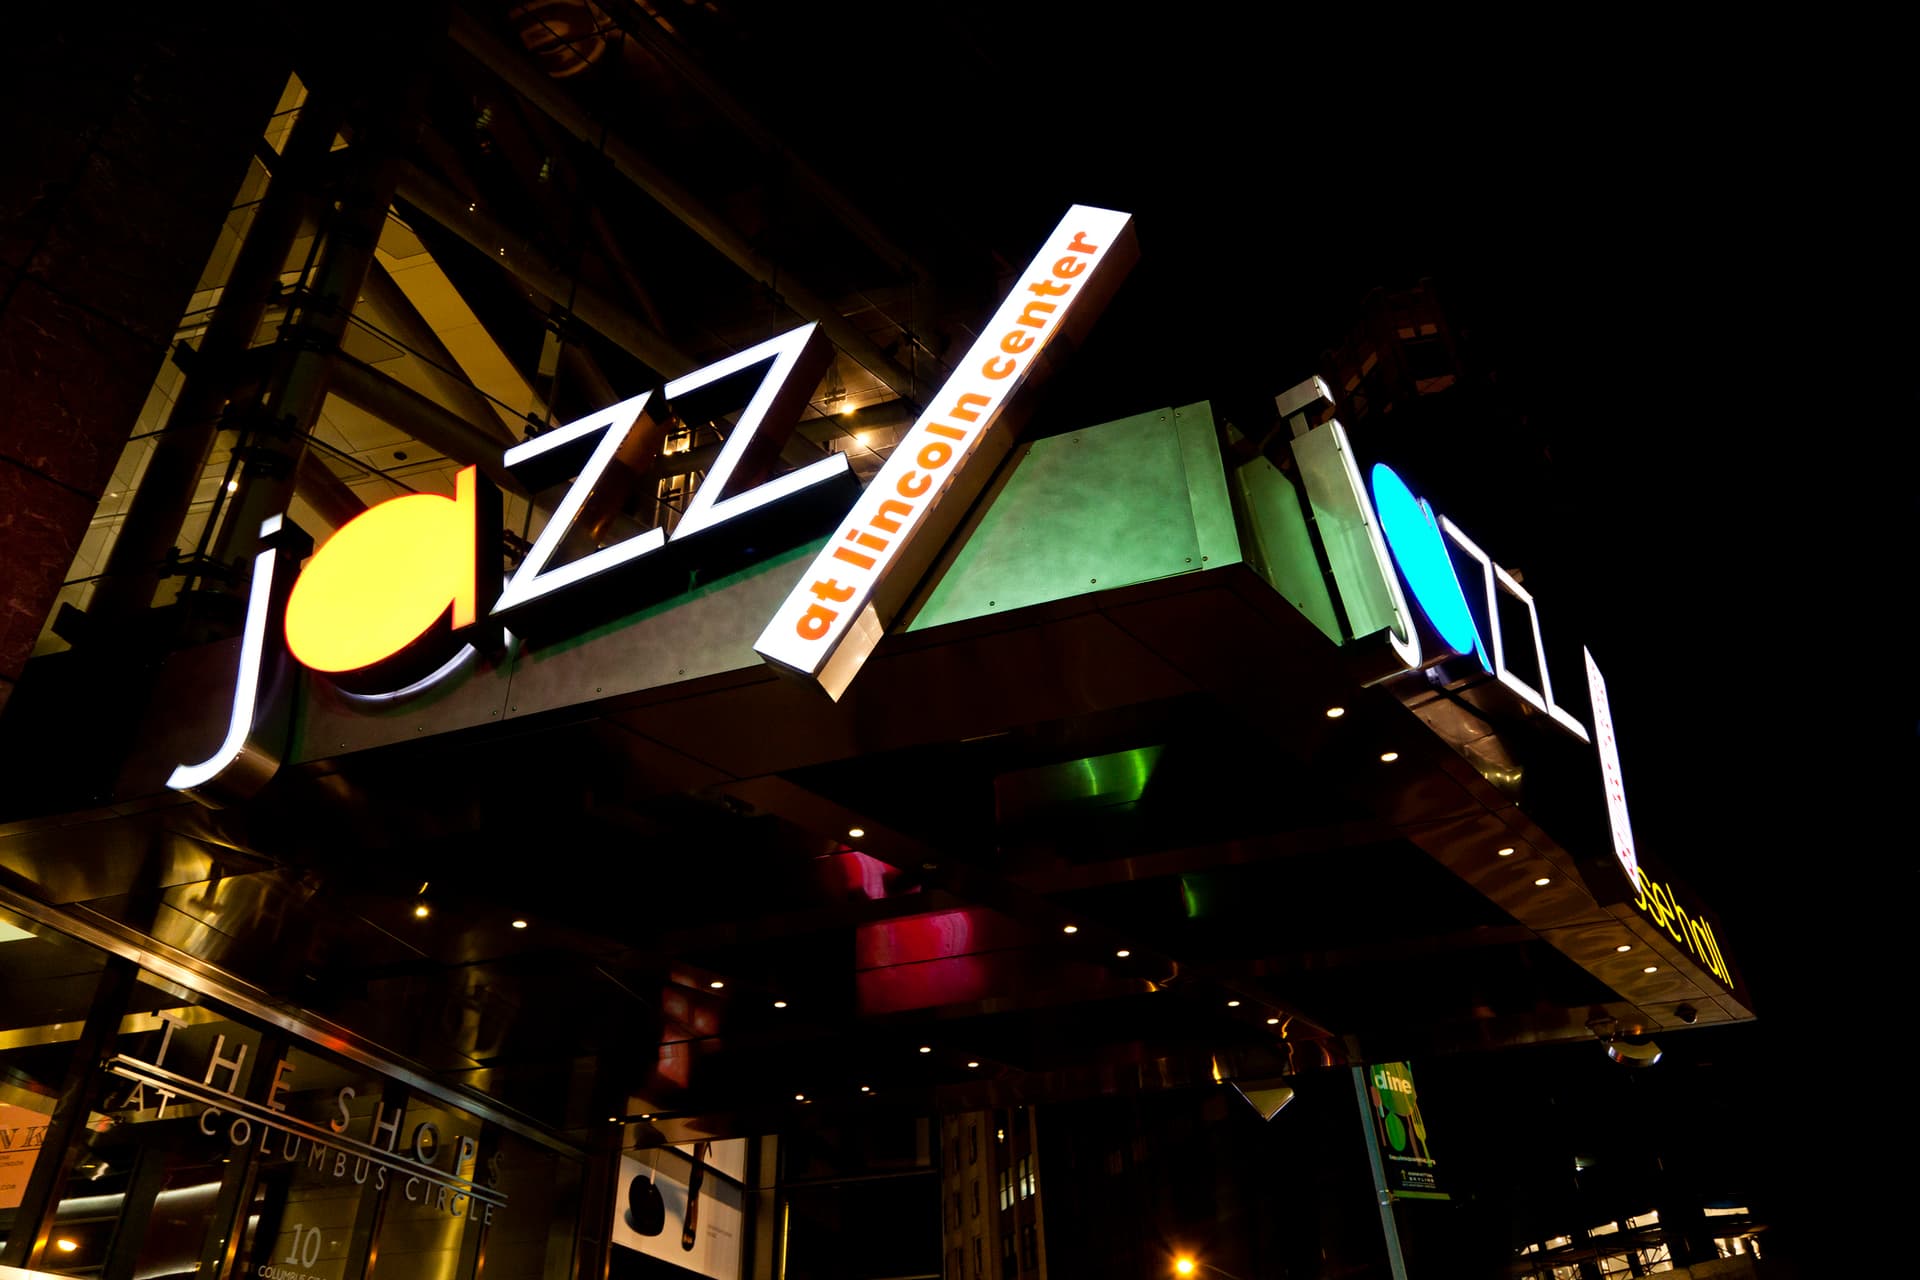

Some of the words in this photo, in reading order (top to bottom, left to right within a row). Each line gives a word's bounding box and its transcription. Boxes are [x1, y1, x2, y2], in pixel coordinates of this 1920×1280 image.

[795, 577, 856, 641] at
[832, 391, 992, 571] lincoln
[981, 230, 1099, 381] center
[166, 321, 849, 789] jazz
[1665, 882, 1734, 990] hall
[119, 1079, 177, 1119] AT
[199, 1106, 389, 1191] COLUMBUS
[404, 1176, 496, 1226] CIRCLE
[156, 1009, 296, 1113] THE
[329, 1085, 505, 1188] SHOPS
[1374, 1069, 1413, 1095] dine
[285, 1223, 321, 1269] 10
